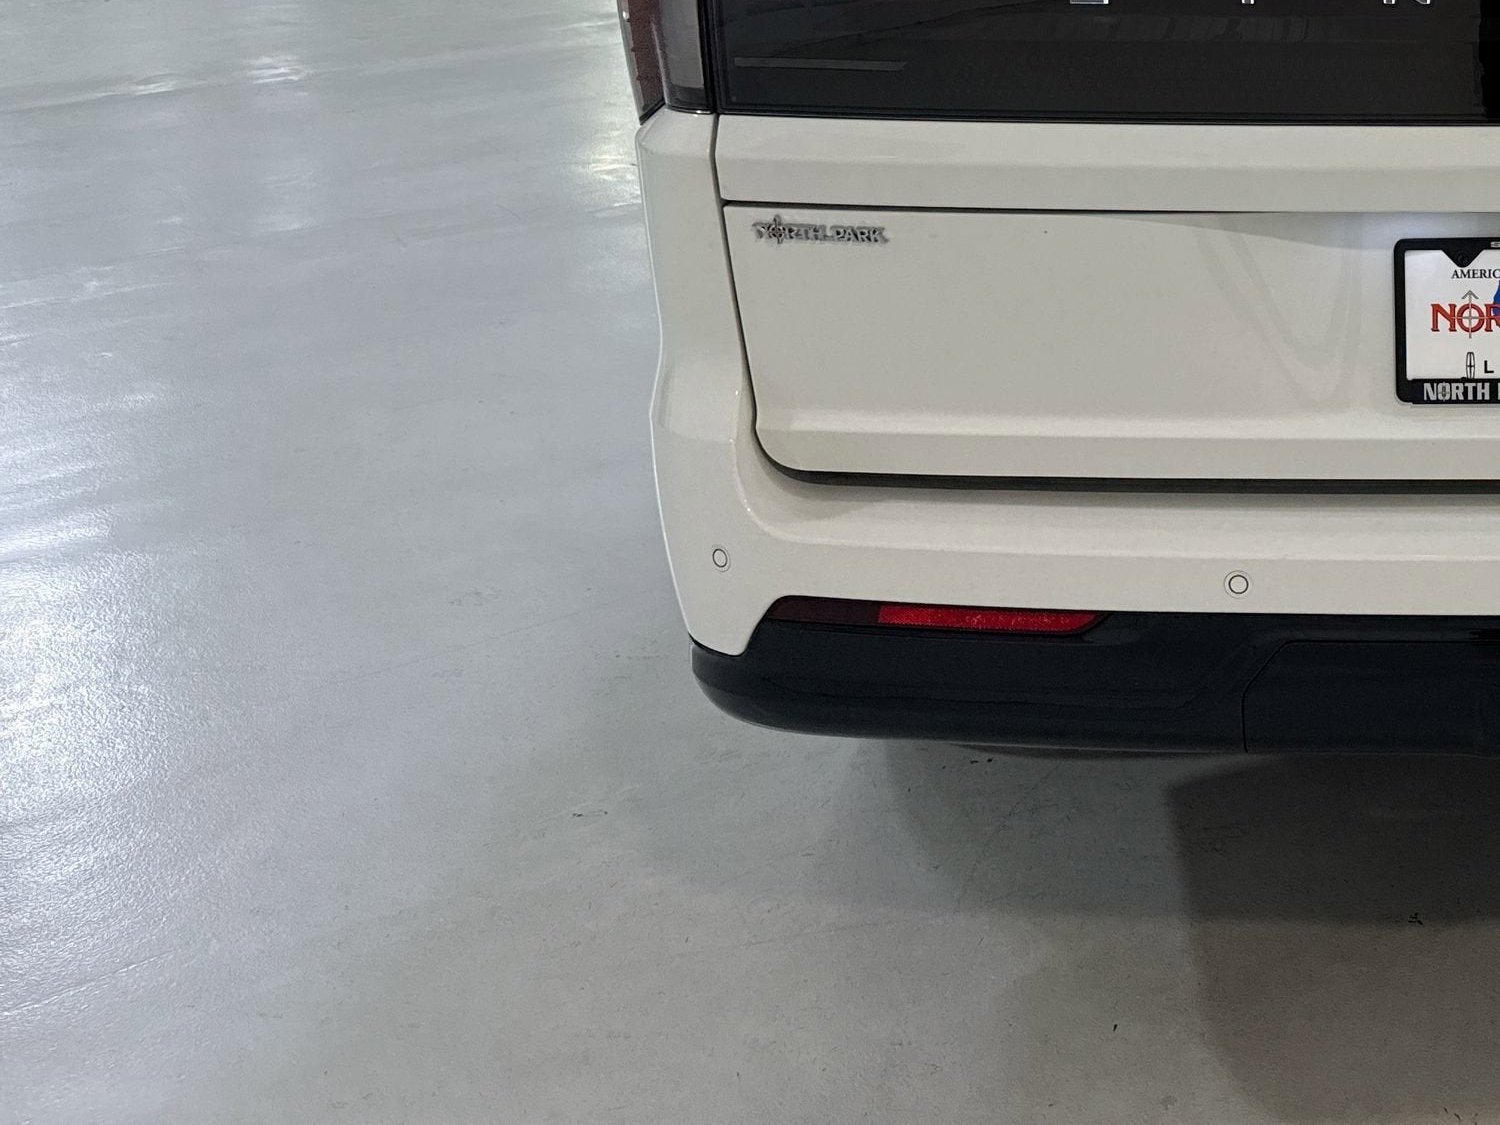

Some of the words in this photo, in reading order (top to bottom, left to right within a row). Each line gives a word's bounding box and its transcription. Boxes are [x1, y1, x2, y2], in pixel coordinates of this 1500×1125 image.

[753, 221, 827, 243] NORTH
[830, 225, 889, 243] PARK
[1423, 382, 1490, 401] NORTH
